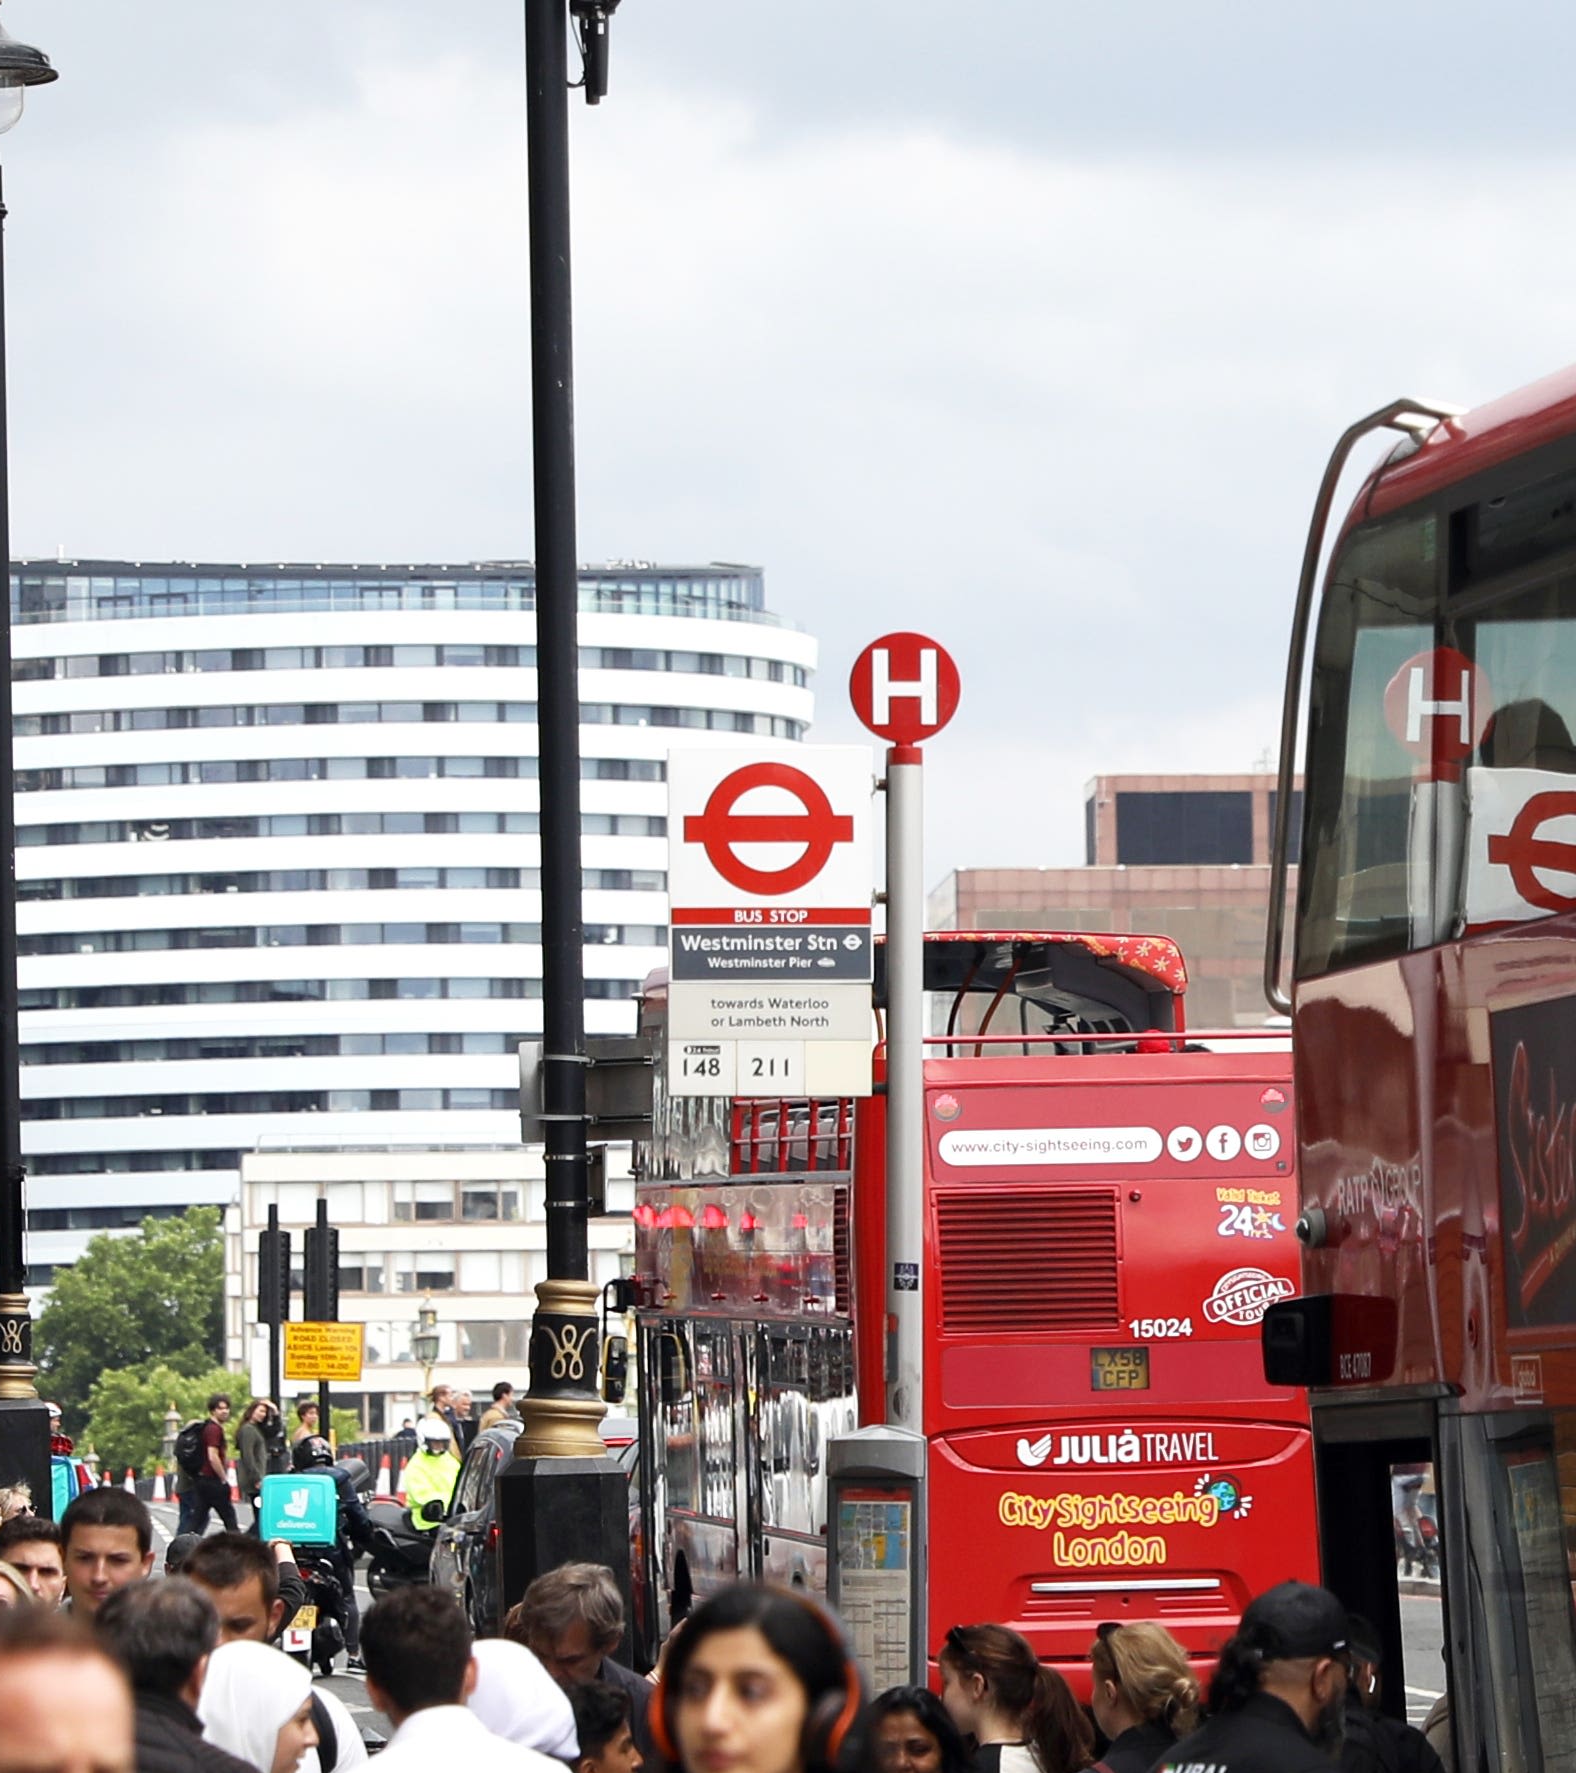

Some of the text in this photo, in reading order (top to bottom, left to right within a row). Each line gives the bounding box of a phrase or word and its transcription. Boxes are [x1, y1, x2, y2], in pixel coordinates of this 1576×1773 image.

[872, 648, 938, 725] H
[734, 909, 809, 924] BUS STOP
[681, 933, 838, 952] Westminster Stn
[707, 956, 813, 969] Westminster Pier
[710, 998, 829, 1010] towards Waterloo
[711, 1015, 829, 1027] or Lambeth North
[683, 1057, 791, 1078] 148 211
[951, 1139, 1148, 1155] www.city-sightseeing.com
[1217, 1204, 1254, 1236] 24
[1212, 1280, 1289, 1316] OFFICIAL
[1128, 1319, 1193, 1339] 15024
[1094, 1350, 1144, 1367] LX58
[1102, 1370, 1140, 1387] CFP
[1142, 1432, 1219, 1462] TRAVEL
[276, 1519, 317, 1530] deliveroo
[1053, 1531, 1166, 1566] London
[291, 1631, 304, 1645] L
